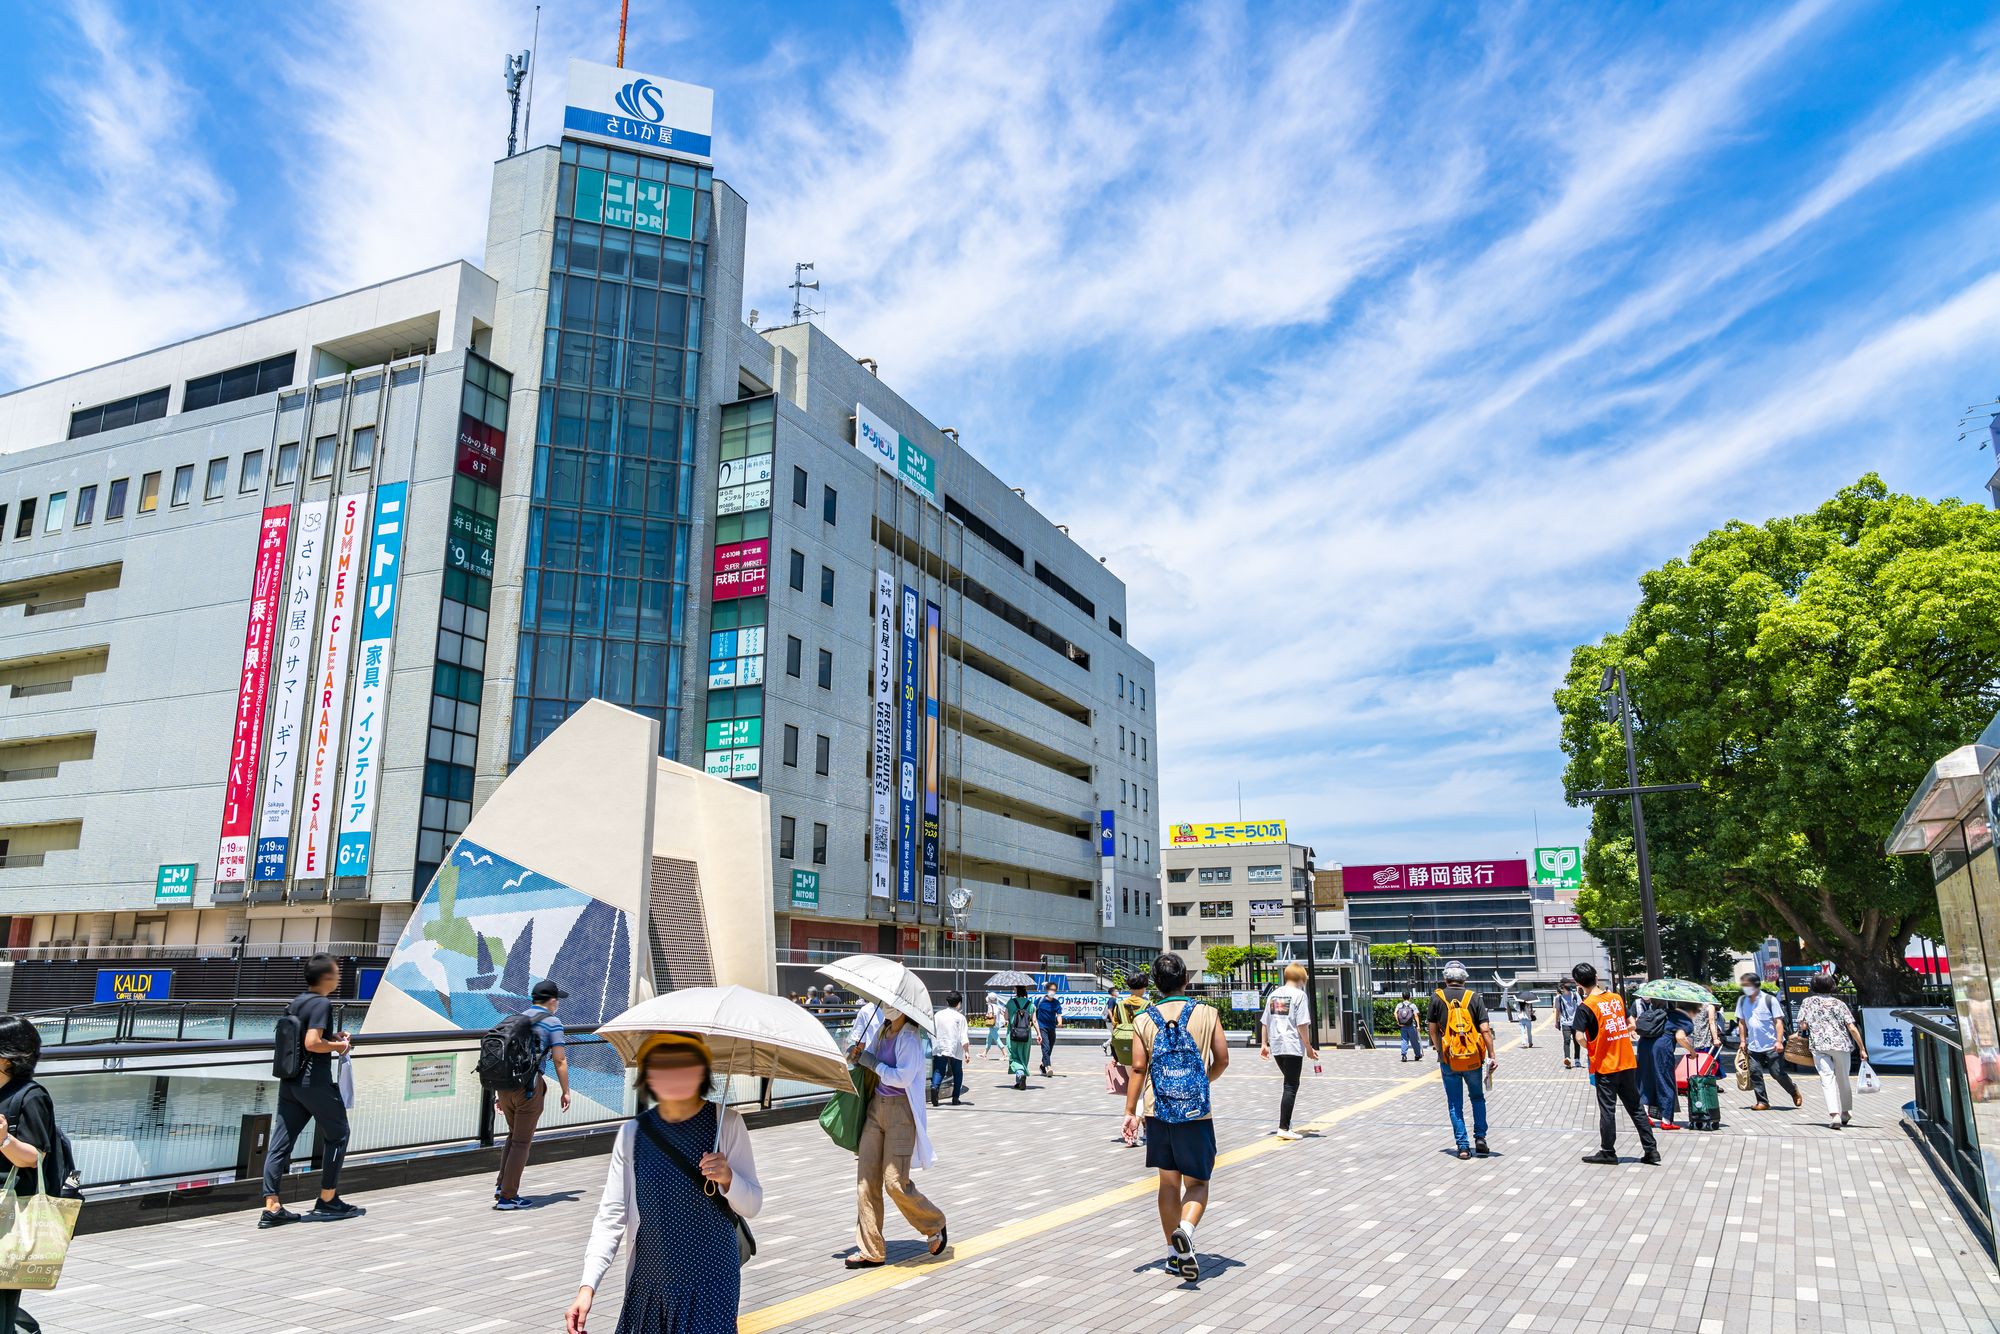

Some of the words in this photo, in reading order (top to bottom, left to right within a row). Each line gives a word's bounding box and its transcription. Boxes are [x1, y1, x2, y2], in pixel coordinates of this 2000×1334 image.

[606, 117, 673, 144] さいか屋
[601, 178, 670, 211] ニトリ
[599, 205, 668, 230] NITORI
[473, 460, 487, 473] 8F
[907, 446, 926, 472] ニトリ
[760, 470, 770, 479] 8F
[907, 464, 926, 485] NITORI
[760, 498, 769, 506] 8F
[269, 529, 277, 538] de
[453, 516, 493, 541] 好日山荘
[334, 500, 356, 608] SUMMER
[369, 501, 400, 619] ニトリ
[481, 549, 493, 566] 4F
[724, 563, 740, 571] SUPER
[742, 559, 762, 568] MARKET
[715, 568, 765, 586] 成城石井
[880, 604, 891, 693] 八百屋コウタ
[273, 540, 314, 793] さいか屋のサマーギフト
[713, 678, 730, 686] Aflac
[314, 615, 341, 786] CLEARANCE
[226, 599, 267, 824] 乗り換えキャンペーン
[350, 645, 383, 823] 家具・インテリア
[719, 721, 749, 736] ニトリ
[719, 736, 748, 745] NITORI
[875, 702, 884, 795] VEGETABLES!
[306, 793, 320, 871] SALE
[1204, 824, 1282, 839] ユーミーらいふ
[219, 856, 245, 865] まで開催
[258, 854, 284, 864] まで開催
[163, 868, 189, 883] ニトリ
[226, 868, 237, 878] 5F
[265, 866, 276, 876] 5F
[1408, 865, 1495, 886] 静岡銀行
[162, 885, 187, 893] NITORI
[796, 873, 815, 889] ニトリ
[796, 890, 814, 899] NITORI
[114, 974, 152, 992] KALDI
[1597, 998, 1622, 1016] 整体
[1605, 1016, 1628, 1034] 骨盤
[27, 1264, 43, 1274] On
